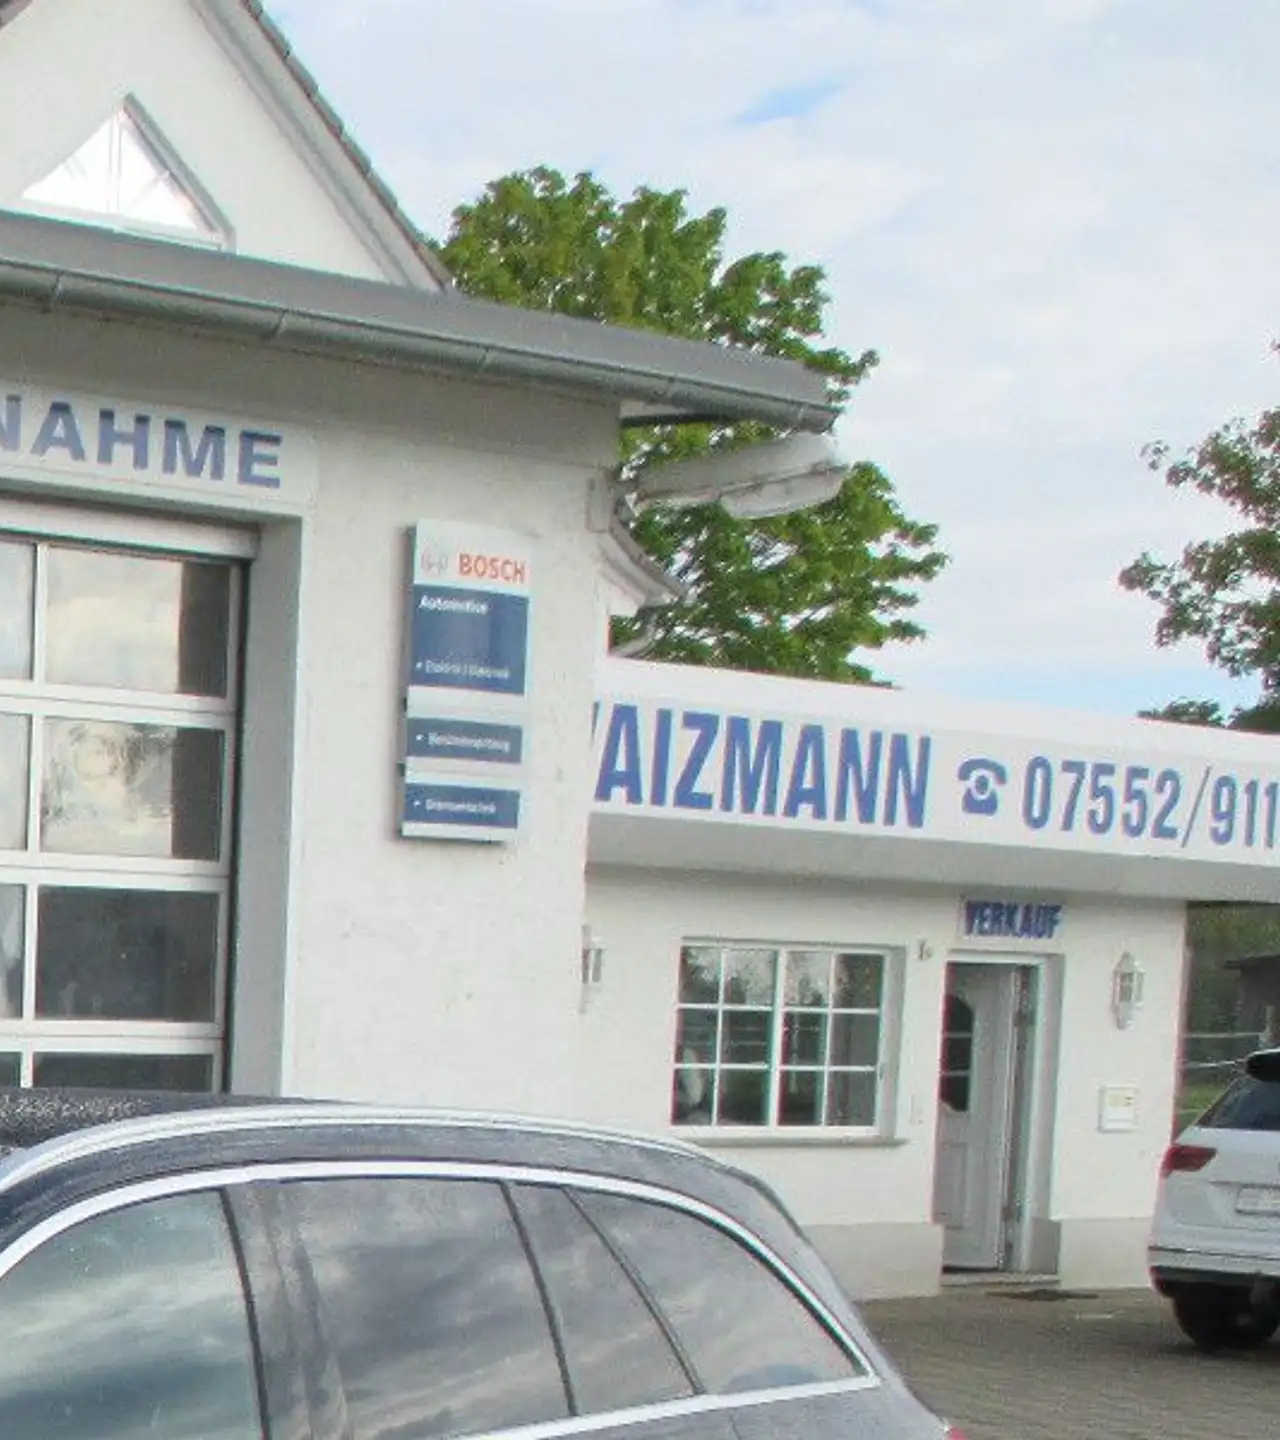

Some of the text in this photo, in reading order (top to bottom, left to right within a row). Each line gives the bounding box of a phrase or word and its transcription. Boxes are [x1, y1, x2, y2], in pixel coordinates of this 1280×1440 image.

[459, 552, 526, 584] BOSCH
[592, 700, 1279, 850] AIZMANN 07552/911
